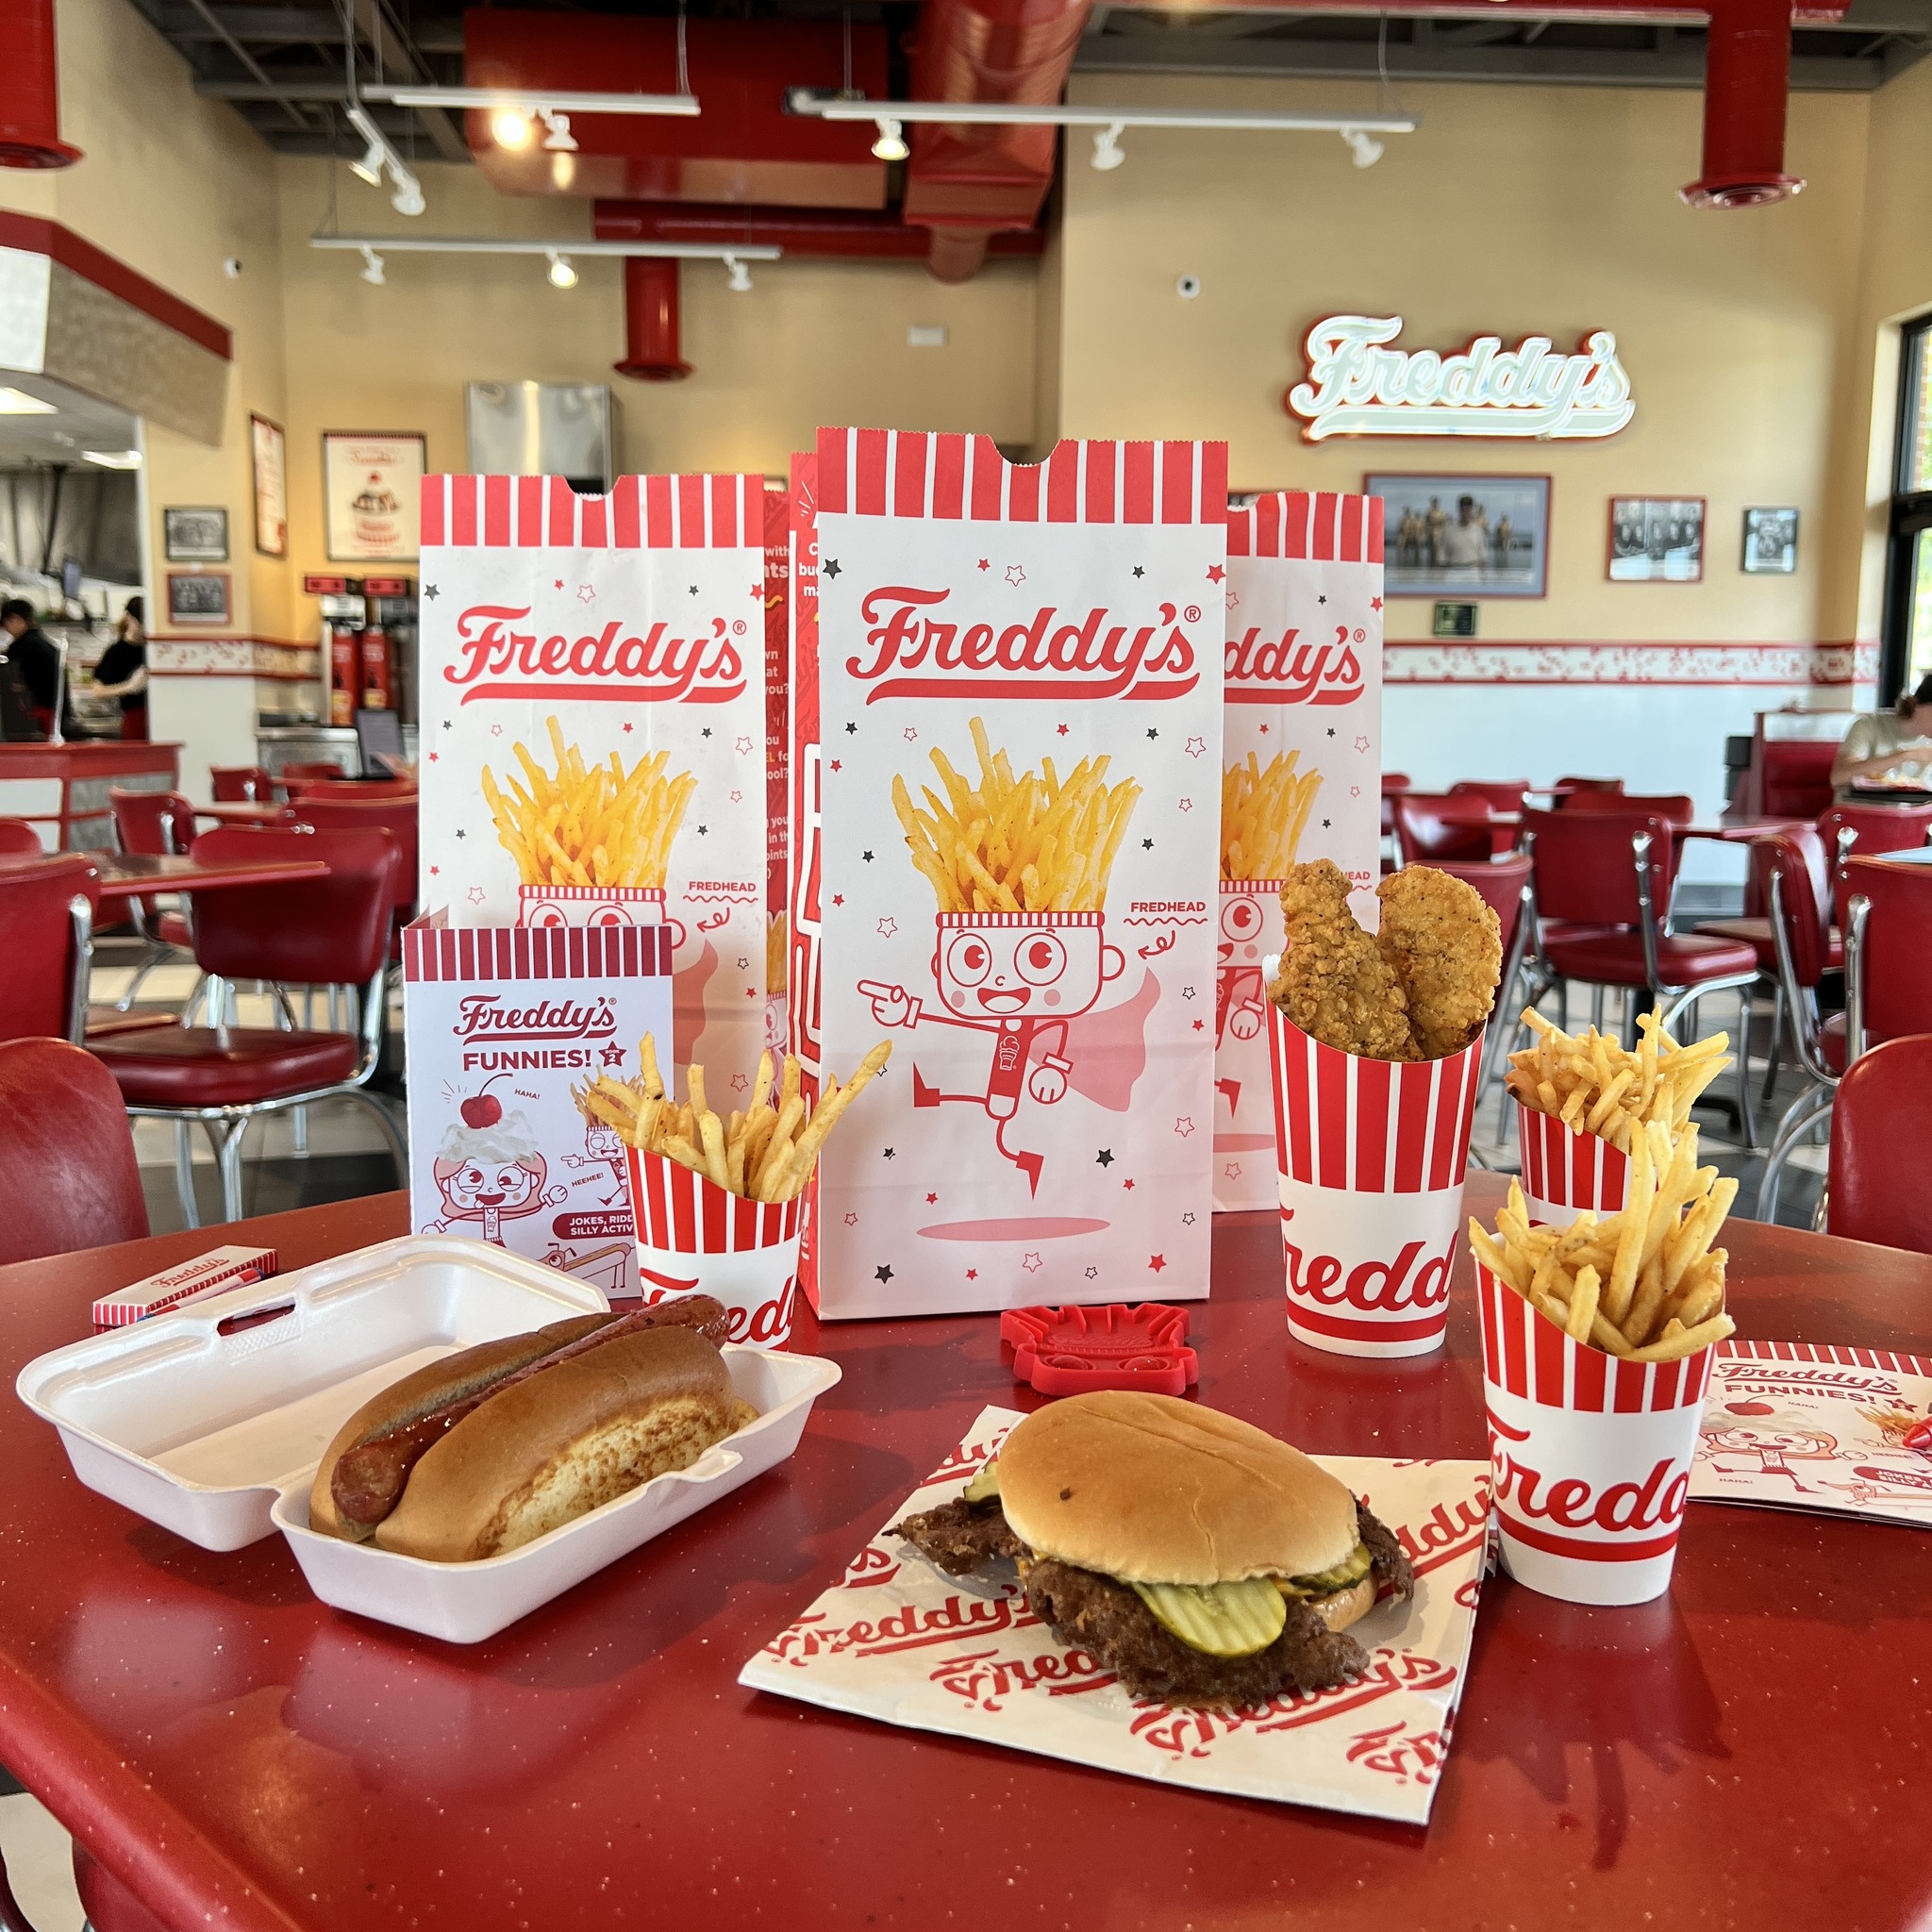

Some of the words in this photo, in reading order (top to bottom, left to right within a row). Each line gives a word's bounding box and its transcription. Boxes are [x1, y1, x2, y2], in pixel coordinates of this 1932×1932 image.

[1287, 314, 1637, 441] Freddy's
[689, 880, 757, 892] FREDHEAD
[1130, 901, 1207, 912] FREDHEAD
[462, 1049, 591, 1072] FUNNIES!
[514, 1088, 541, 1100] HAHA!
[571, 1172, 604, 1188] HEEHEE!
[569, 1216, 607, 1226] JOKES,
[570, 1225, 599, 1236] SILLY
[1724, 1384, 1877, 1405] FUNNIES!
